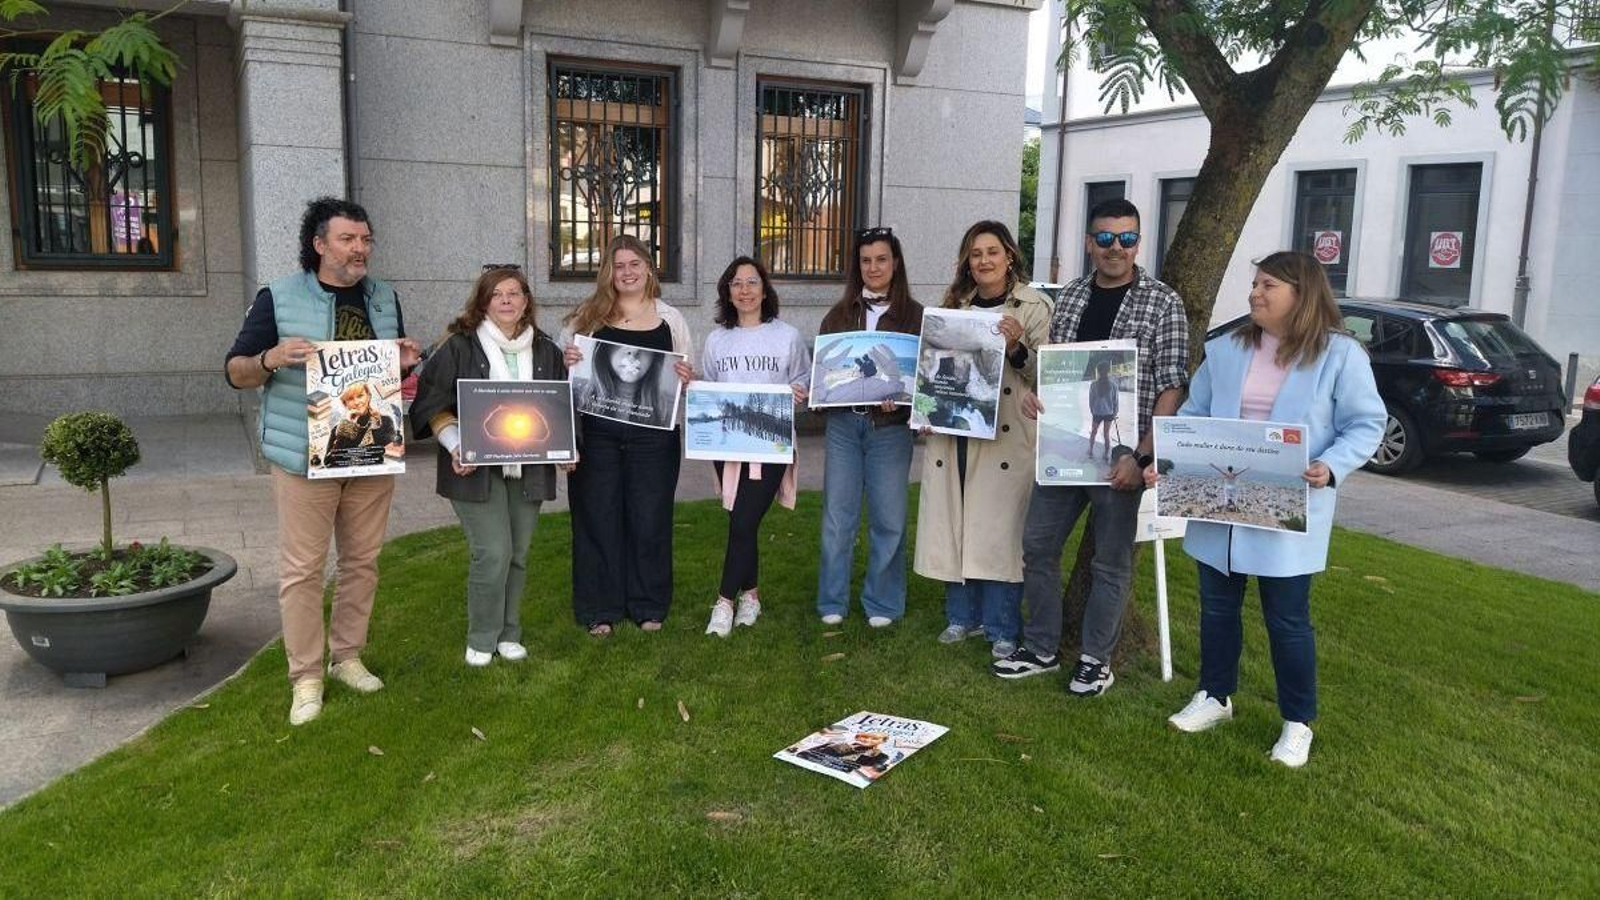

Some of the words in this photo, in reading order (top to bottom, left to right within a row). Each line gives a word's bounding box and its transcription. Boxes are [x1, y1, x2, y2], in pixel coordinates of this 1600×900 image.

[317, 344, 379, 378] Letras
[744, 355, 780, 373] YORK
[320, 362, 384, 397] Galegas
[851, 714, 921, 731] Letras
